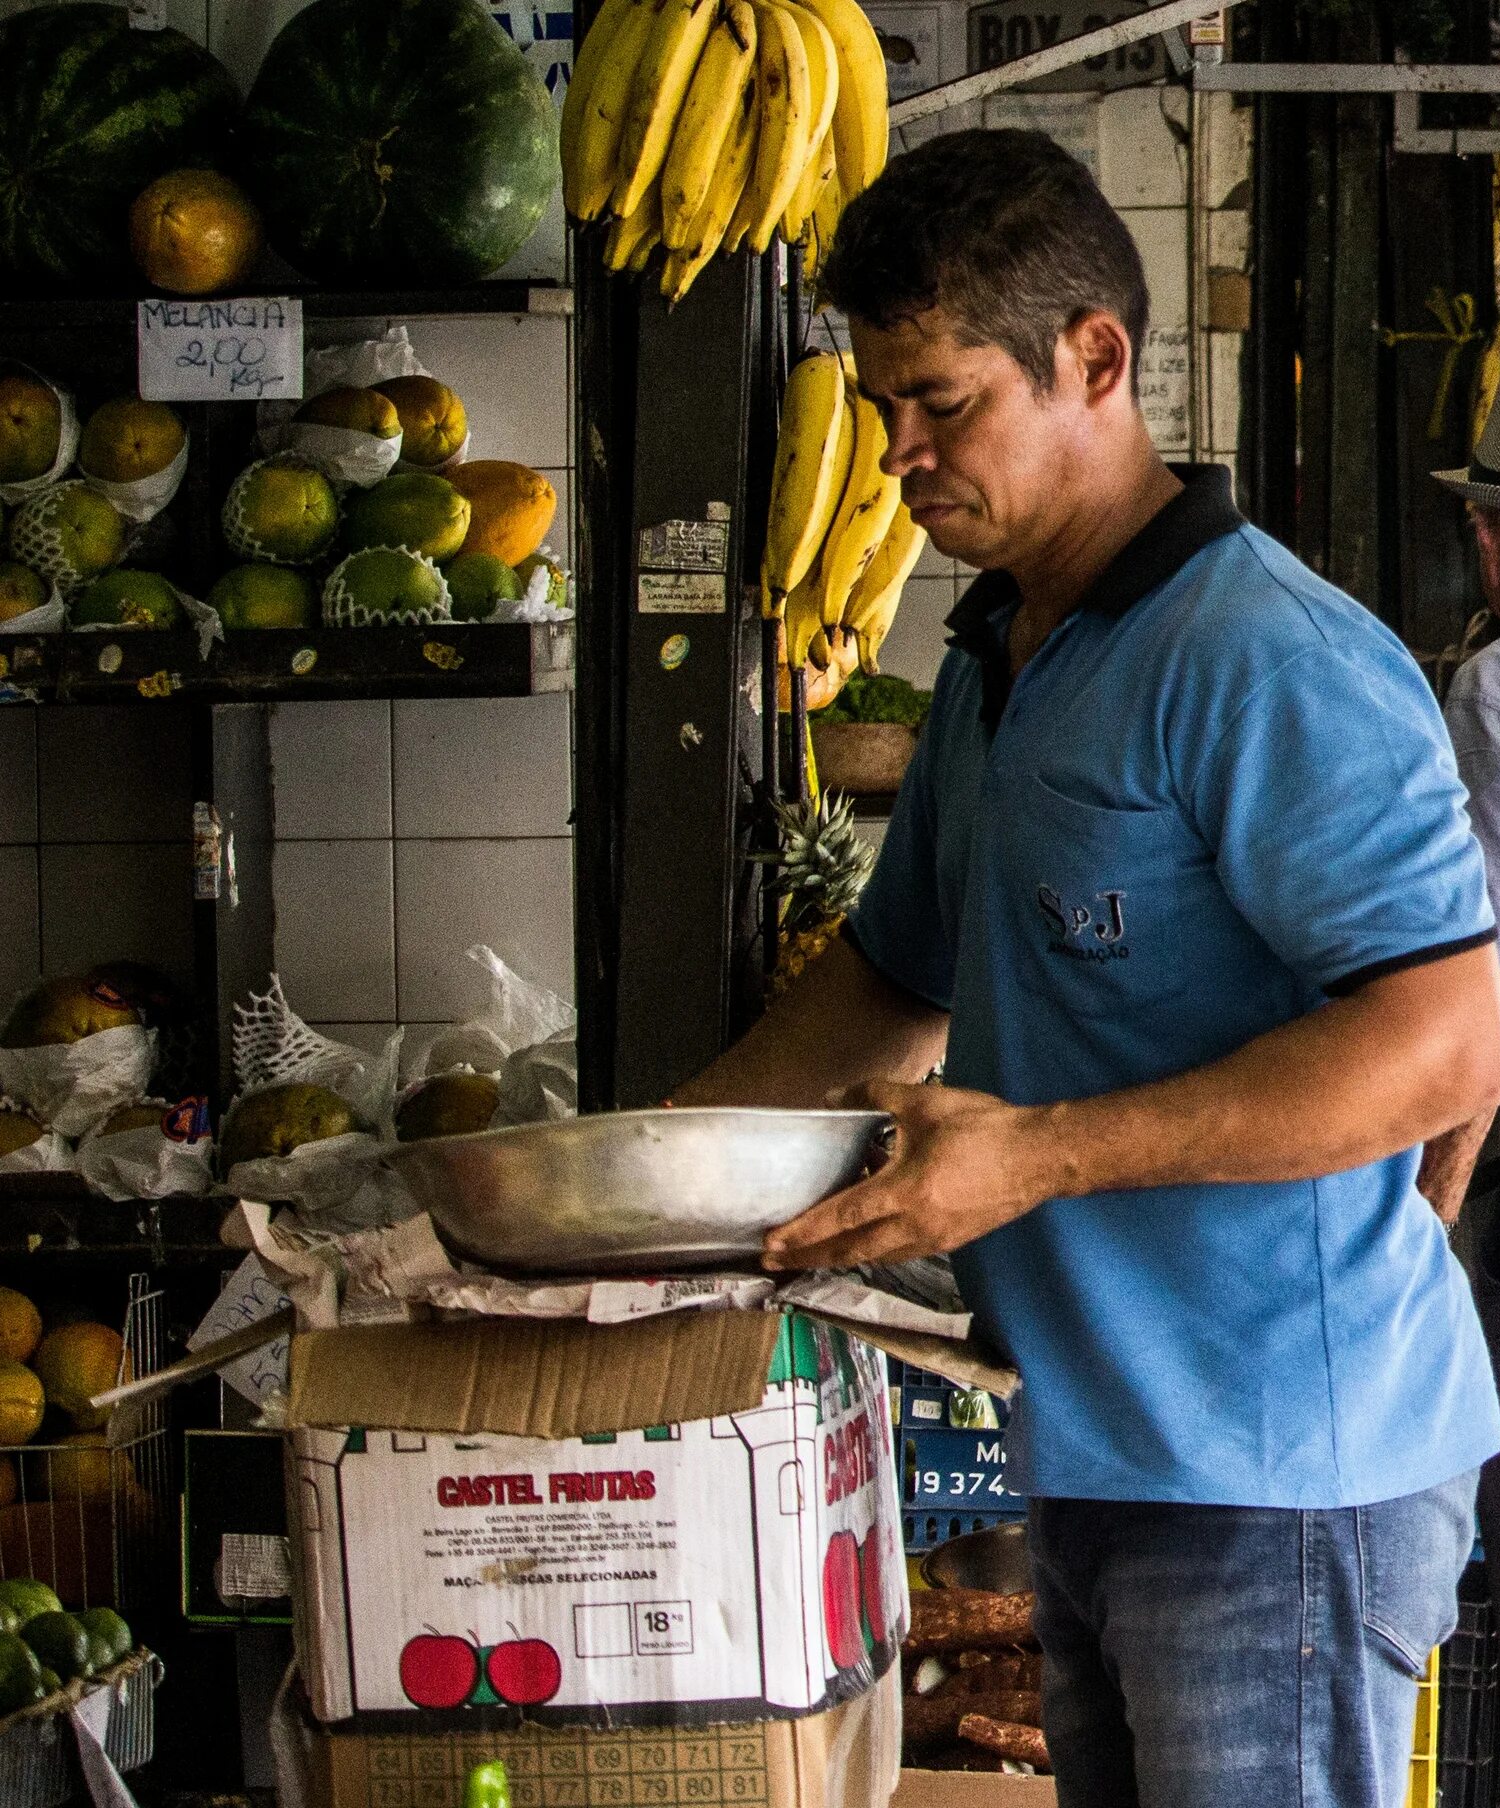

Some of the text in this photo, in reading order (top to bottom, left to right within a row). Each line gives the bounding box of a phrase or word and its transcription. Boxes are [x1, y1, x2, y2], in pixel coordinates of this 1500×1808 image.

[144, 302, 285, 328] MELANCIA
[175, 337, 266, 377] 2,00
[437, 1470, 656, 1507] CASTEL FRUTAS
[949, 1472, 1022, 1496] 374
[556, 1570, 658, 1583] SELECIONADAS
[644, 1611, 669, 1633] 18
[550, 1749, 577, 1769] 68
[594, 1748, 621, 1768] 69
[641, 1746, 666, 1767] 70
[687, 1745, 712, 1765] 71
[729, 1743, 756, 1763] 72
[555, 1782, 579, 1802] 77
[597, 1780, 623, 1800] 78
[642, 1778, 668, 1798] 79
[686, 1776, 713, 1797] 80
[732, 1774, 758, 1795] 81
